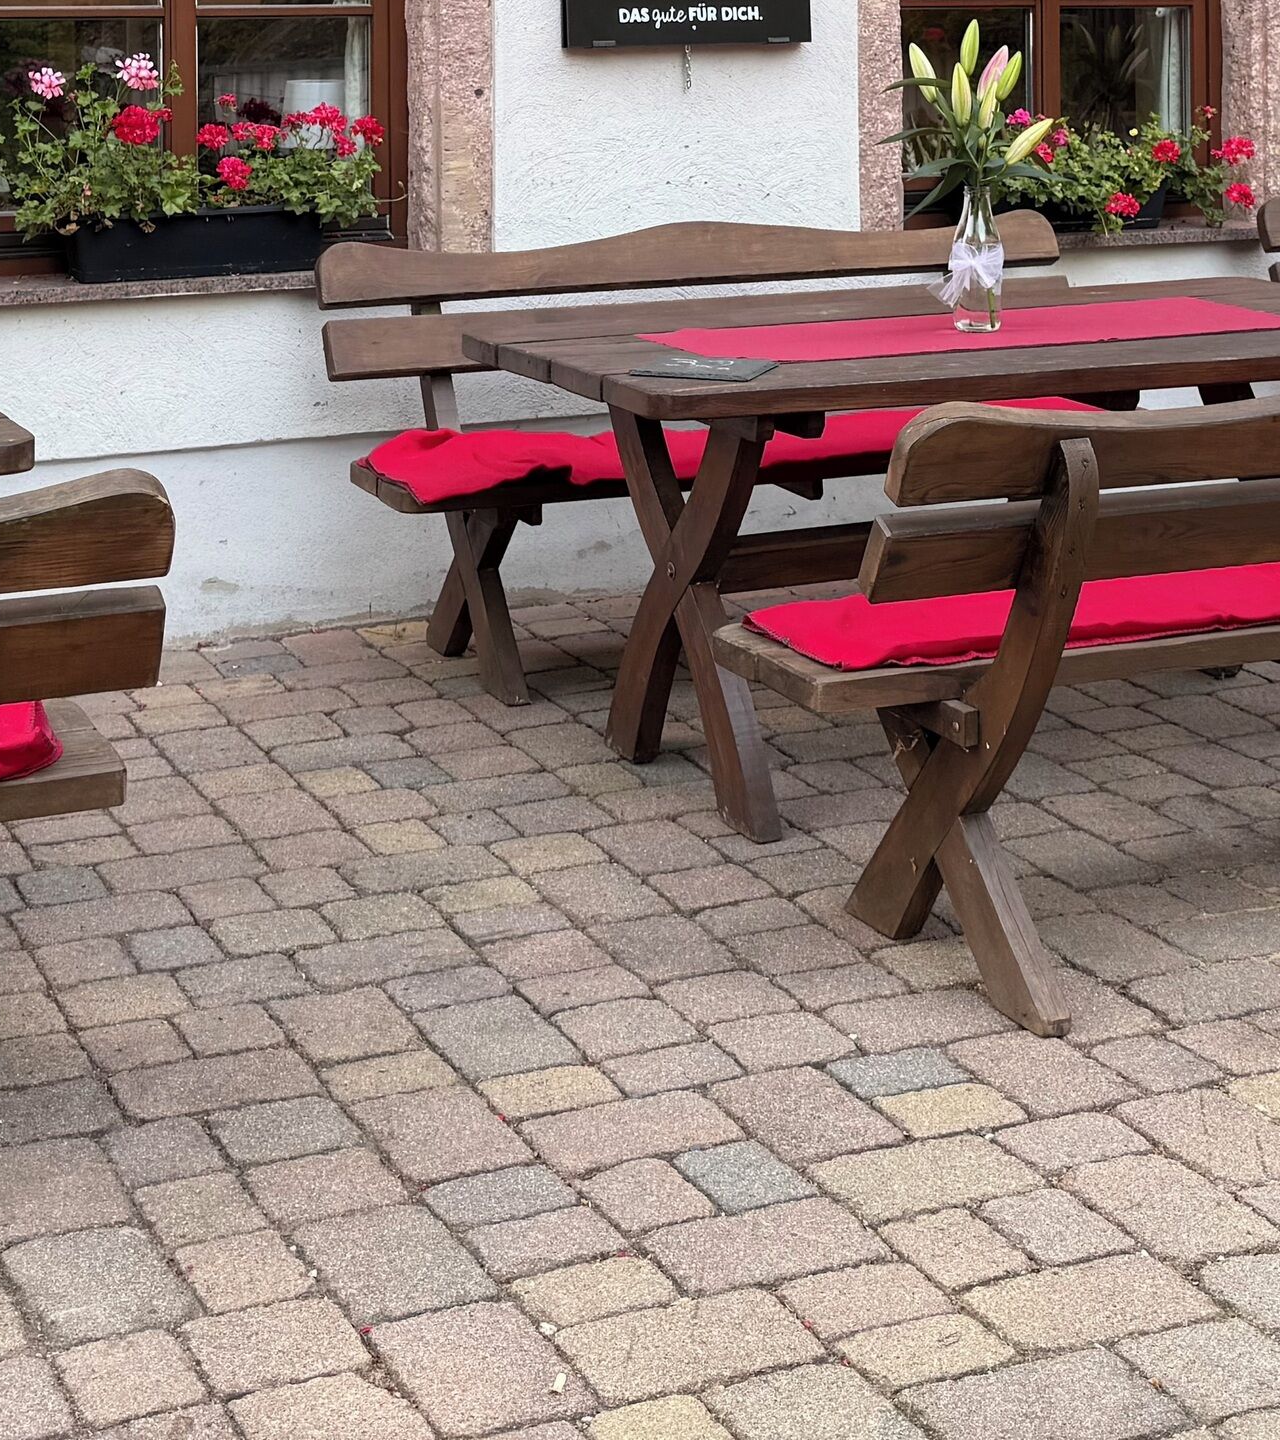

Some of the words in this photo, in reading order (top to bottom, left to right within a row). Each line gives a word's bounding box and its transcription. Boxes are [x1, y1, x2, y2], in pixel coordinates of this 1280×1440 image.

[619, 7, 650, 23] DAS
[652, 6, 687, 29] gute
[688, 3, 718, 21] FÜR
[721, 6, 763, 21] DICH.
